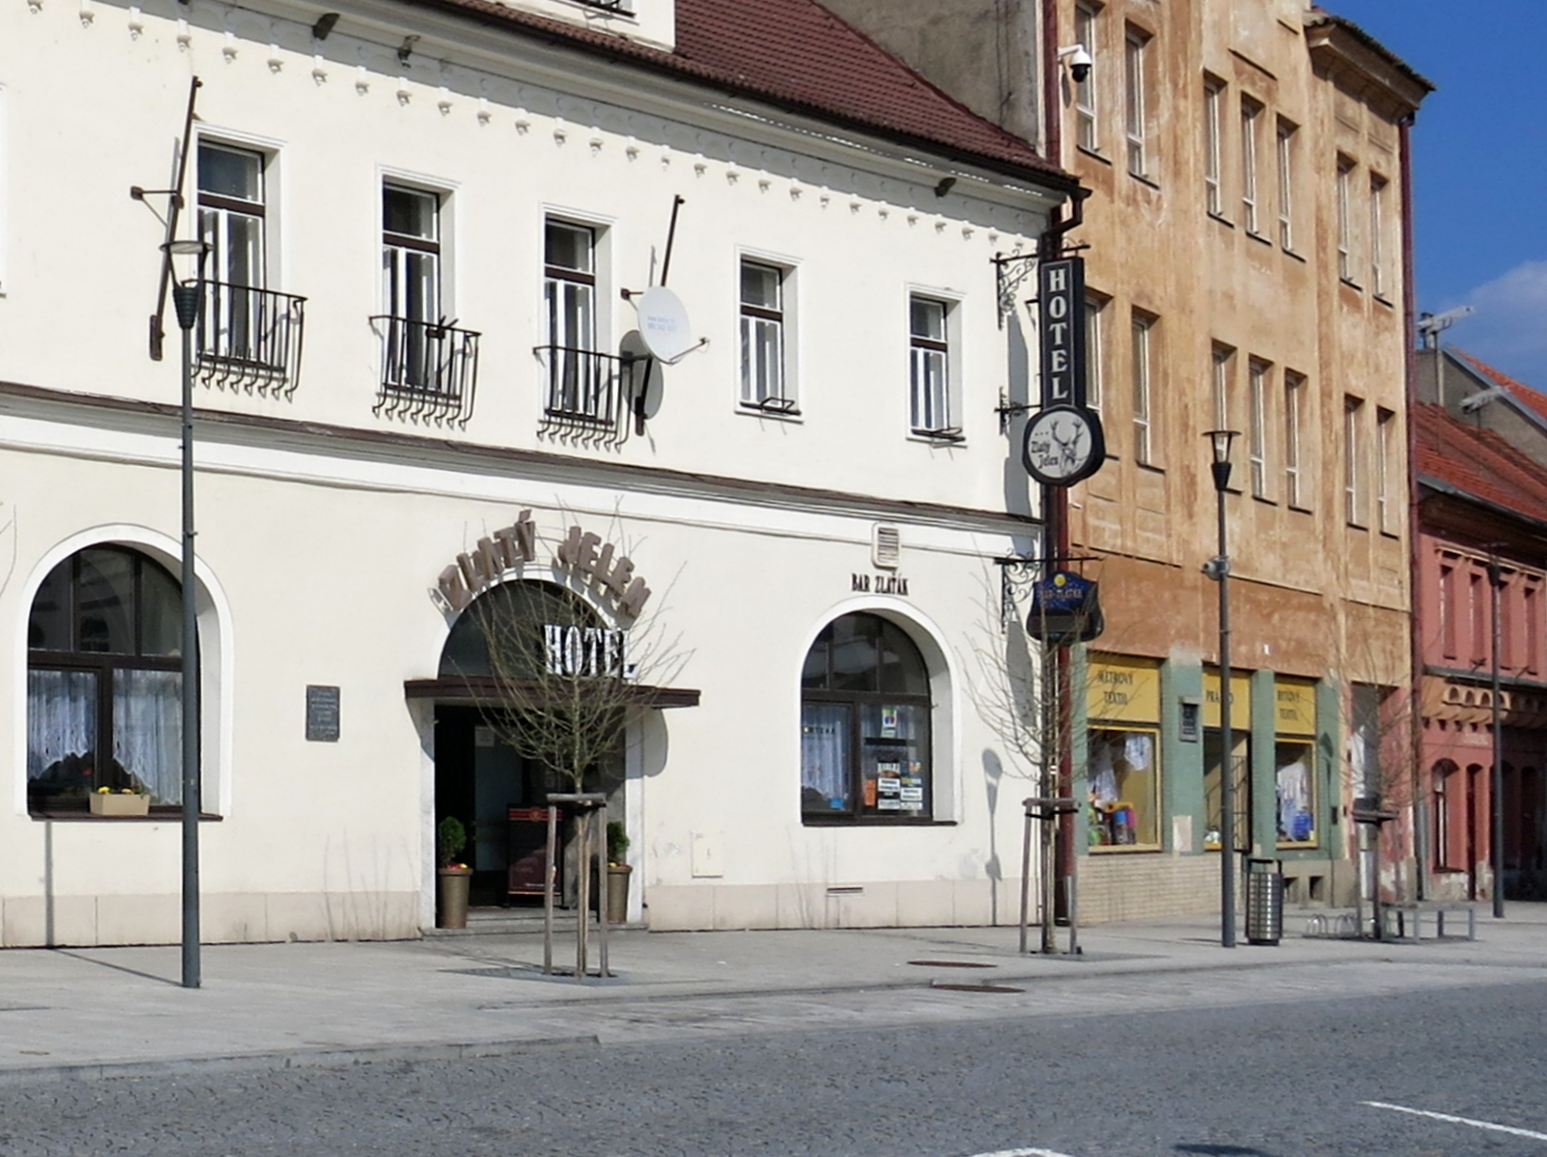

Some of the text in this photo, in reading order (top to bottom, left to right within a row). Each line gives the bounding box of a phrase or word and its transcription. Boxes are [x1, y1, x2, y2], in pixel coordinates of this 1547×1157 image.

[1049, 268, 1068, 399] HOTEL
[438, 509, 652, 619] ZLATÝ JELEN
[851, 573, 870, 592] BAR
[544, 624, 639, 679] HOTEL
